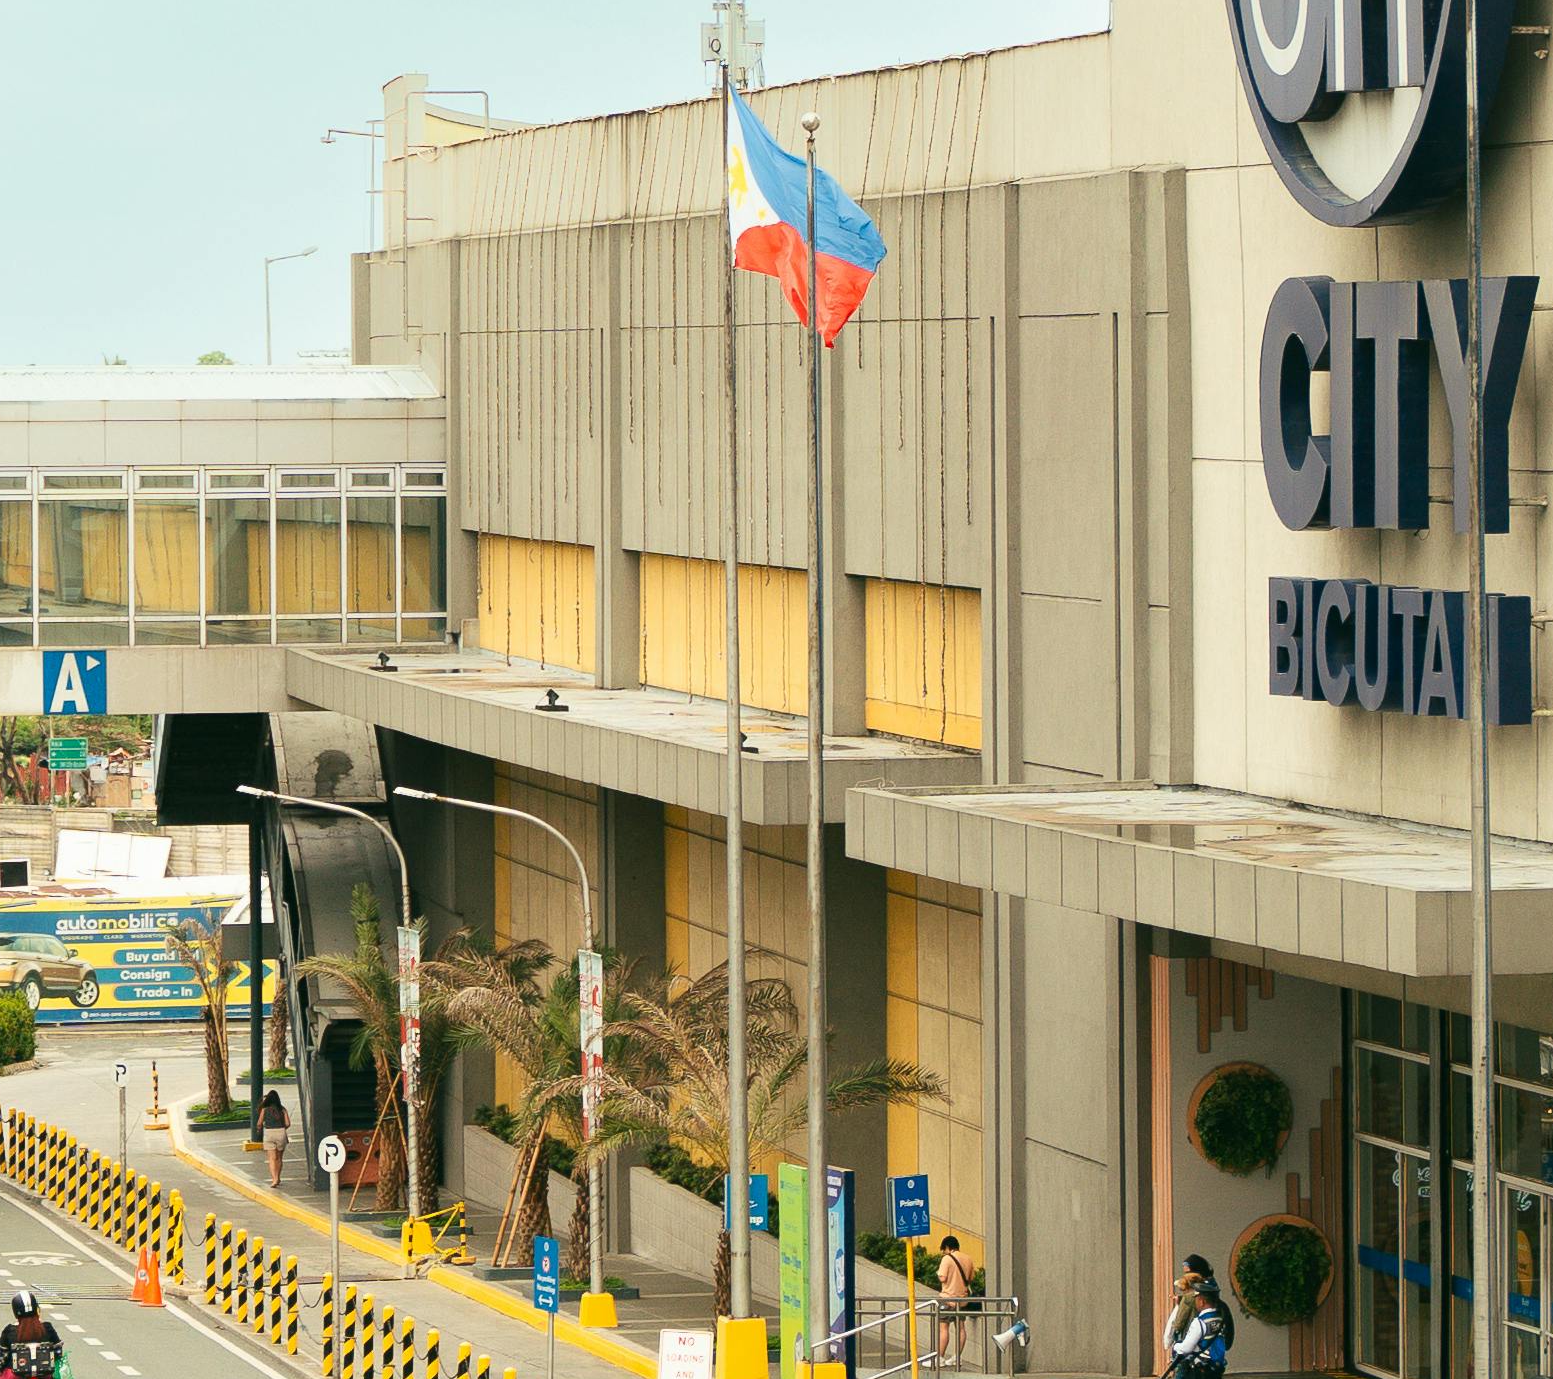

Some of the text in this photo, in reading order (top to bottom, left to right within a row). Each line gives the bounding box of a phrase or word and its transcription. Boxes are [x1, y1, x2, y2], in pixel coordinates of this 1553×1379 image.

[1260, 275, 1539, 533] CITY
[49, 653, 89, 713] A
[125, 951, 150, 964] Buy
[151, 949, 176, 962] and
[119, 968, 171, 982] Consign
[132, 987, 171, 999] Trade
[180, 987, 193, 997] In
[678, 1336, 695, 1347] NO
[666, 1352, 704, 1364] LOADING
[675, 1371, 694, 1379] AND
